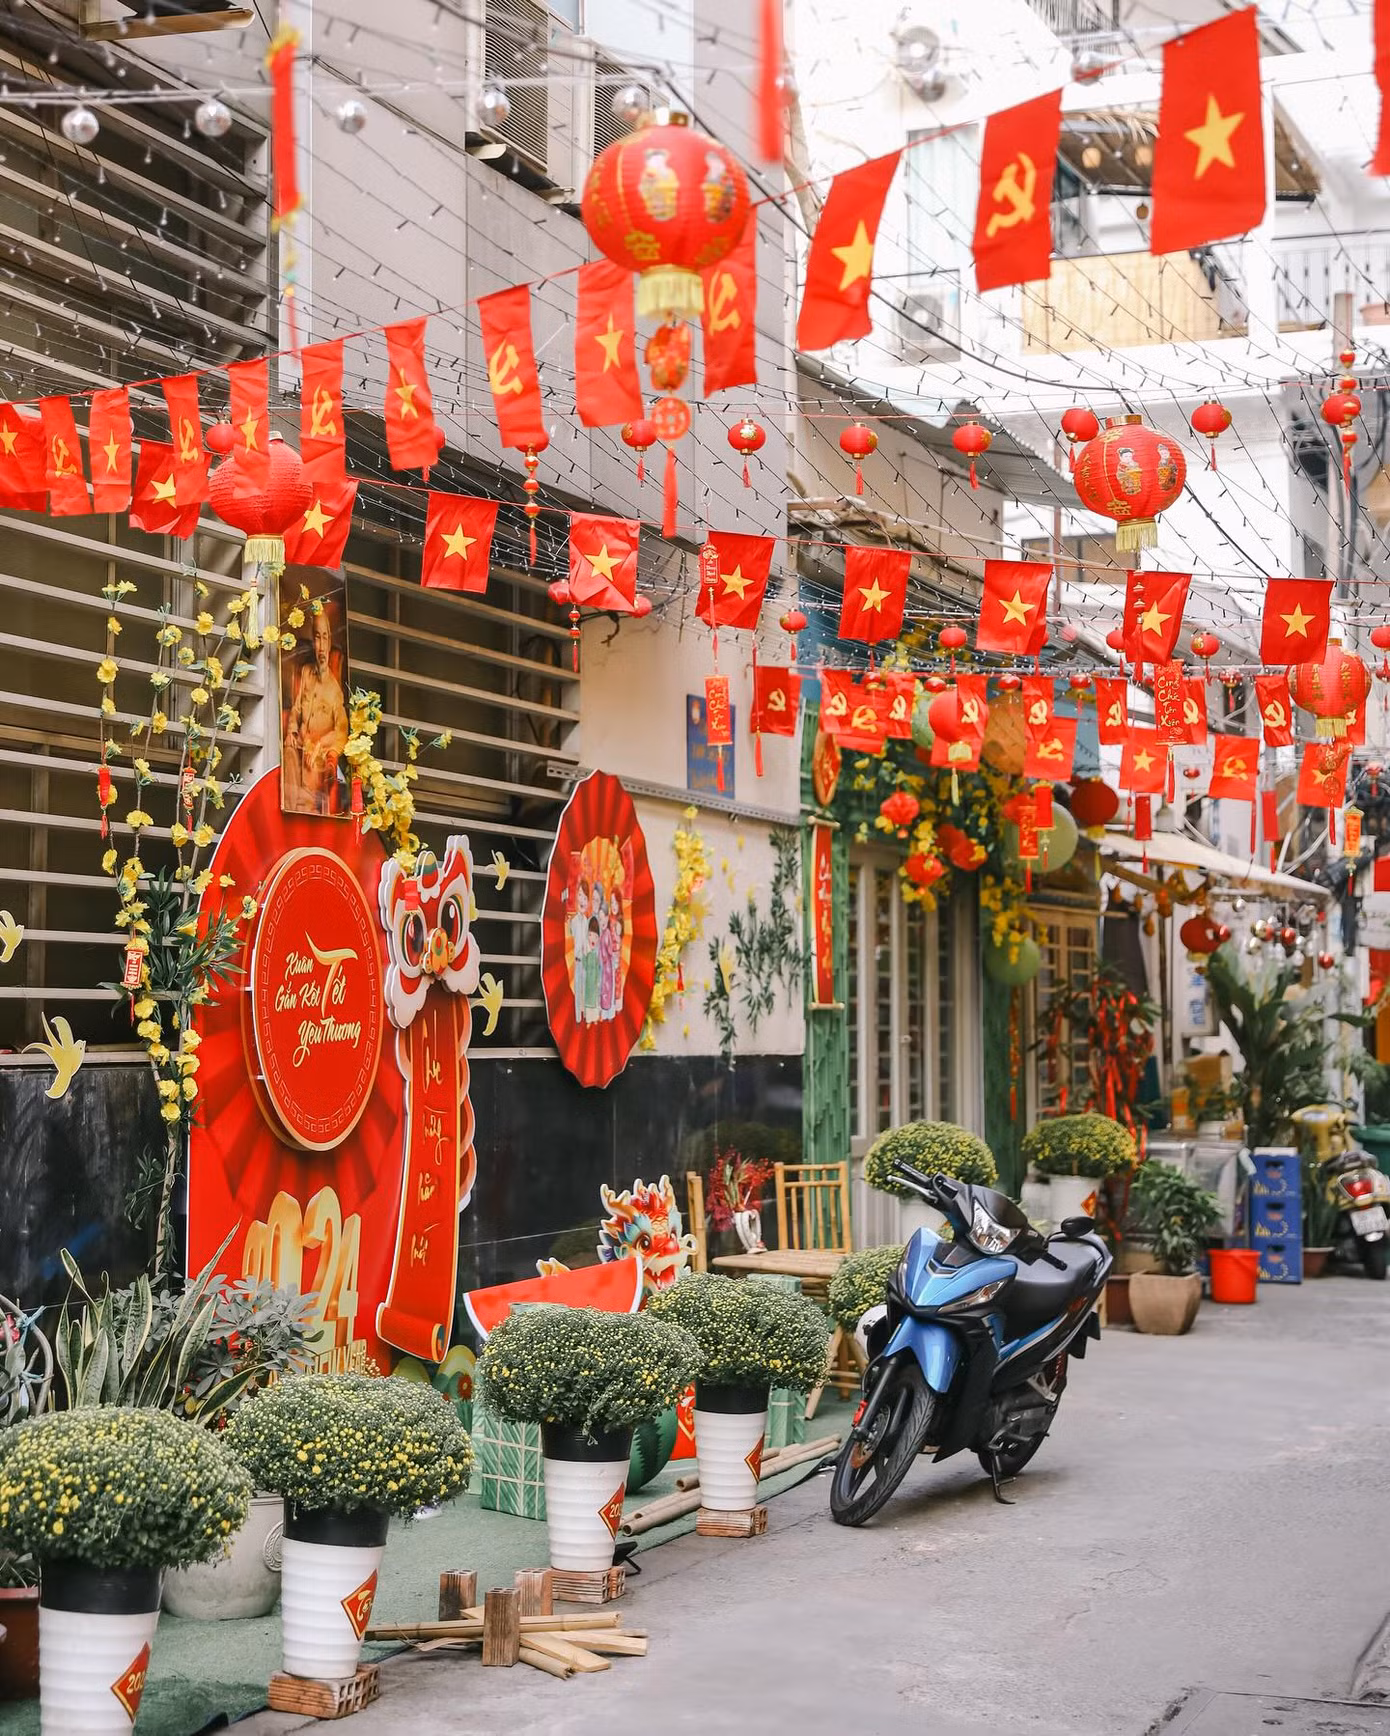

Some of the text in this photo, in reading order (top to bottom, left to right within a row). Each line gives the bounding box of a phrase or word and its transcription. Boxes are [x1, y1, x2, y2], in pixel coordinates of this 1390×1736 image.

[275, 981, 297, 1012] Gắn
[305, 930, 358, 1018] Tết
[285, 951, 313, 980] Xuân
[293, 1019, 322, 1067] Yêu
[242, 1186, 361, 1357] 2024
